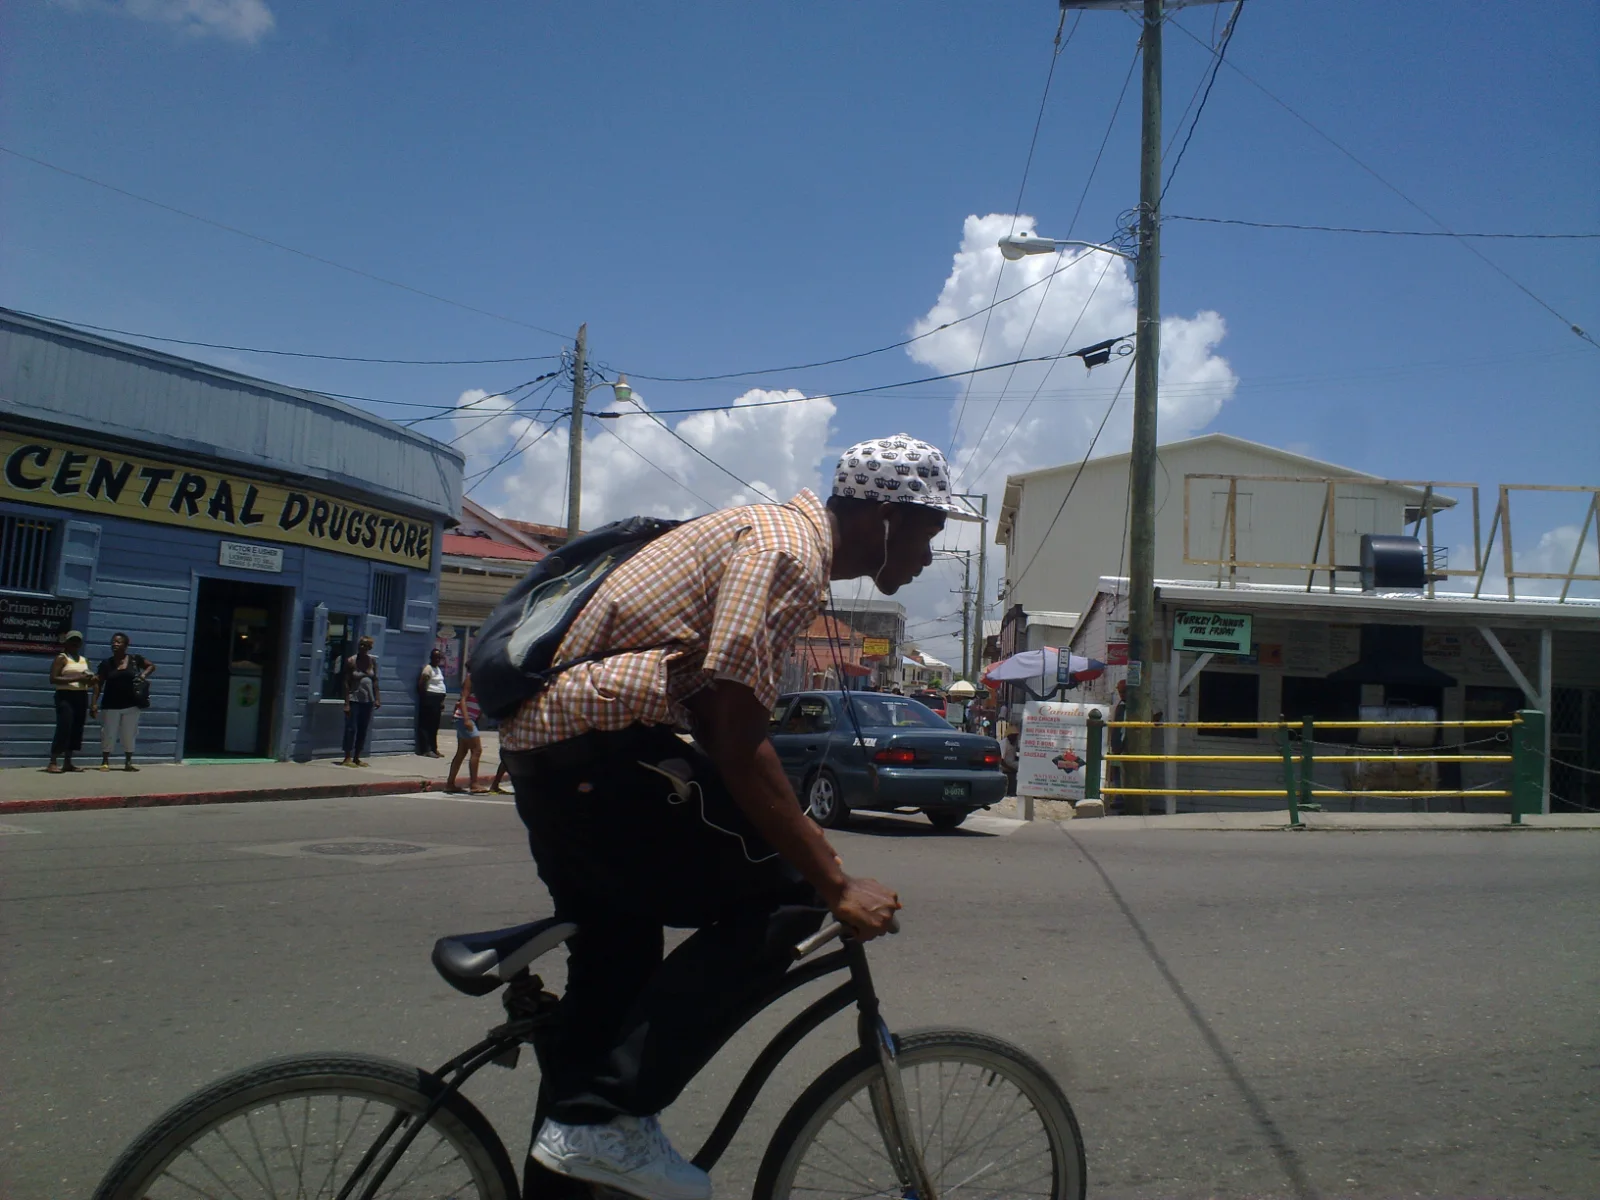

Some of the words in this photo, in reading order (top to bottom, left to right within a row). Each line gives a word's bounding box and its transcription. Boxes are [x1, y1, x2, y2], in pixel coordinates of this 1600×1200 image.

[4, 444, 265, 528] CENTRAL
[278, 492, 432, 560] DRUGSTORE
[0, 599, 39, 614] Crime
[42, 602, 72, 618] info?
[1176, 612, 1211, 625] TURKEY
[1189, 626, 1207, 635] THIS
